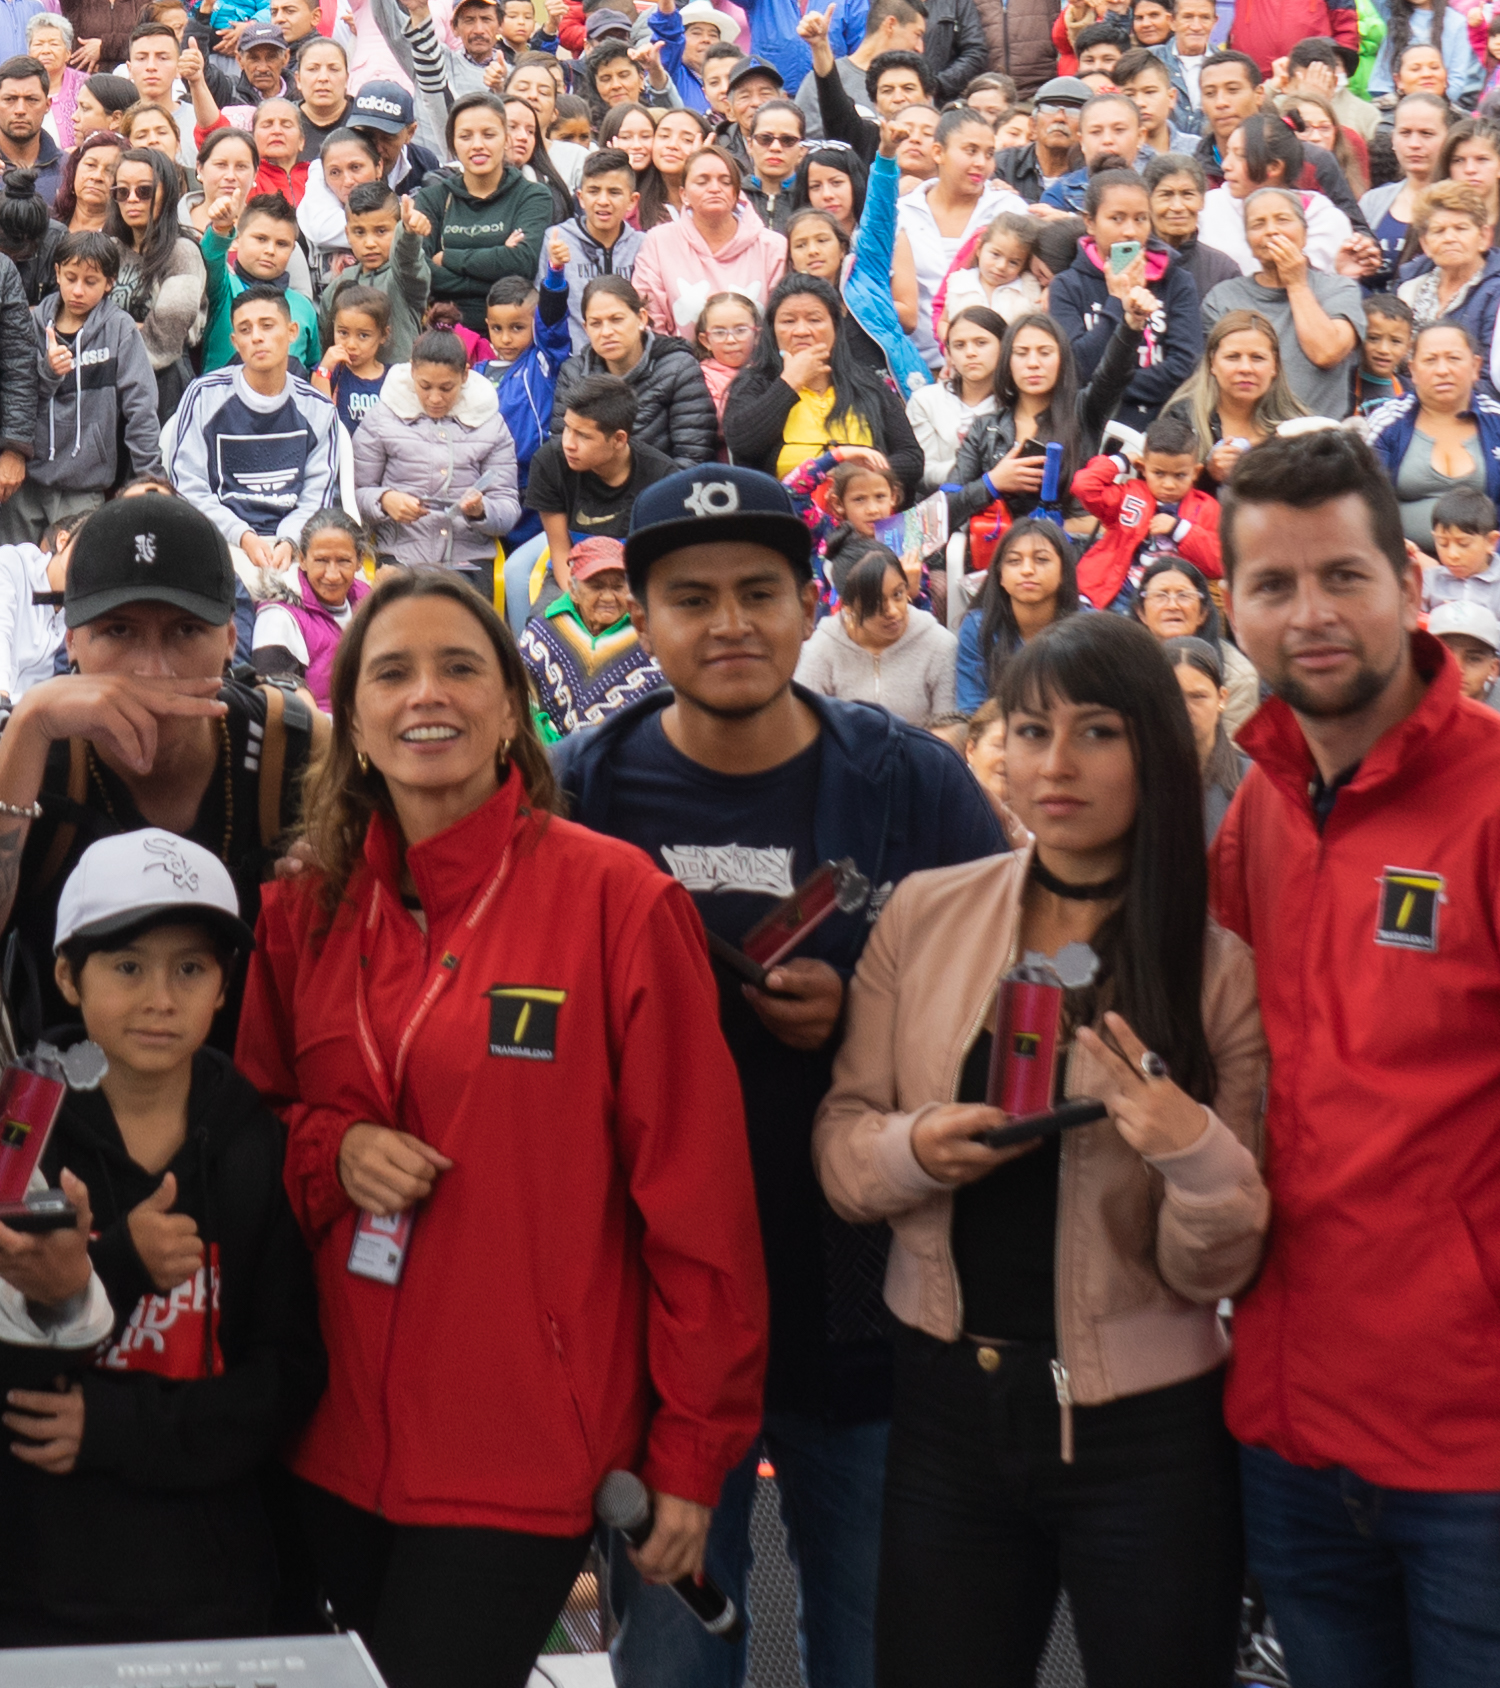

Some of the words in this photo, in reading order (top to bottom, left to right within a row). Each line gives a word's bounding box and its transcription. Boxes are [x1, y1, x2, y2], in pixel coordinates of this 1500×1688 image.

[356, 95, 402, 116] adidas
[1119, 495, 1146, 528] 5
[489, 1044, 554, 1060] TRANSMILENIO
